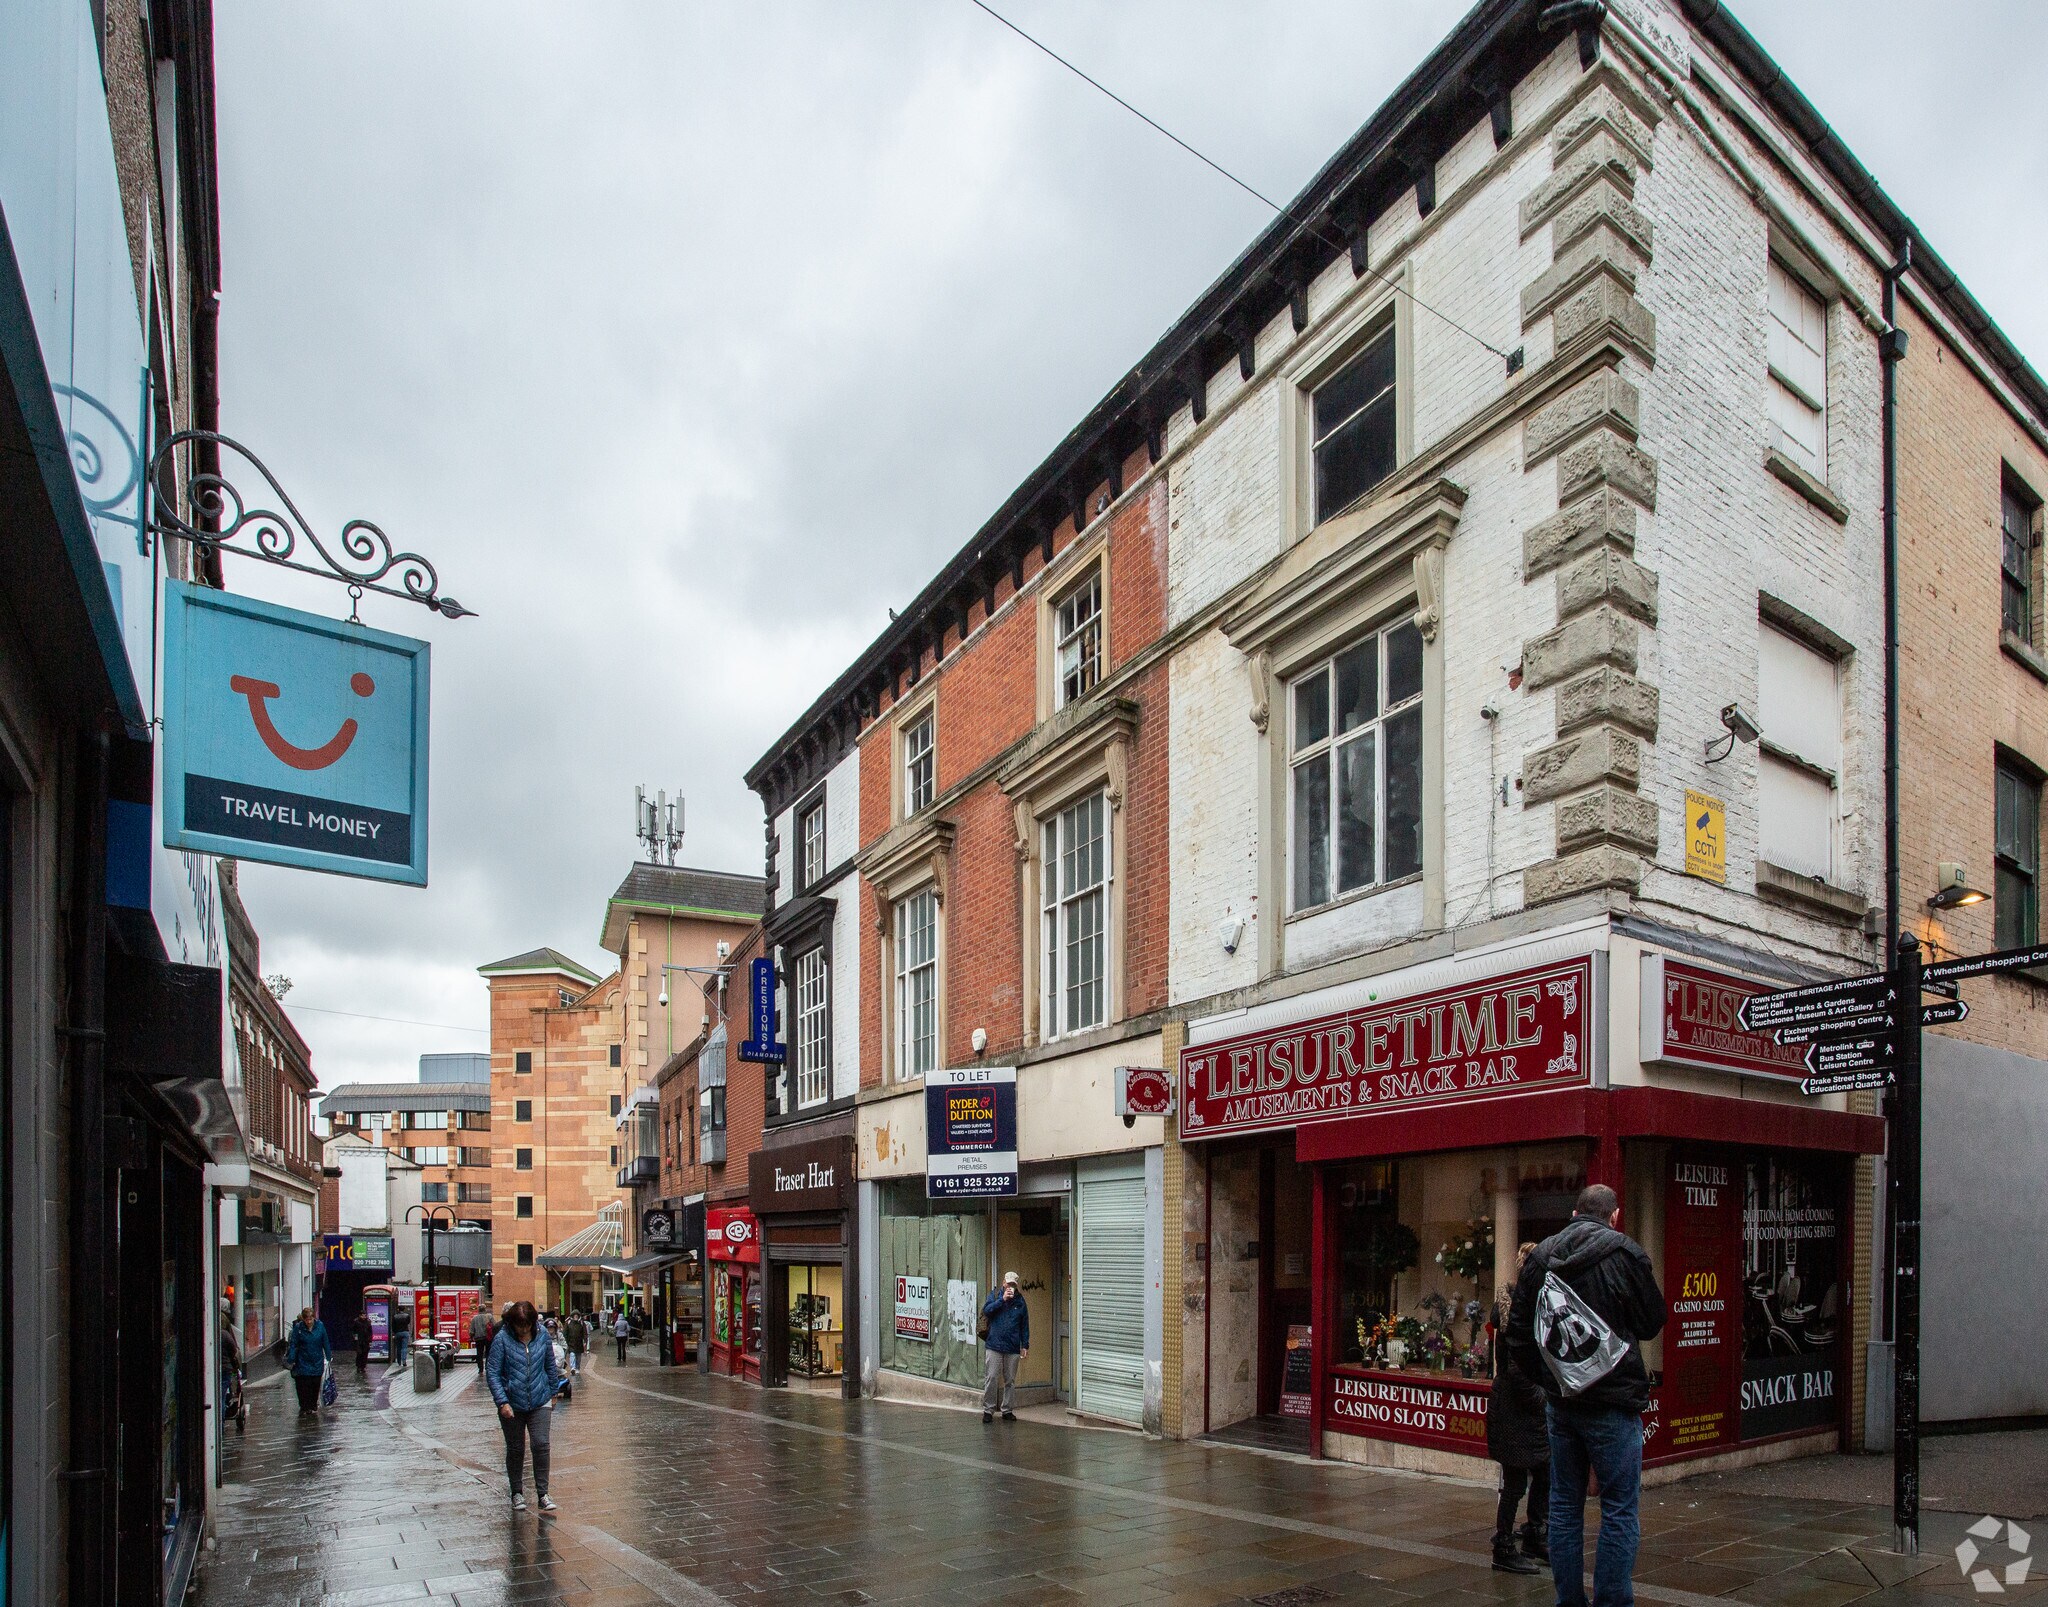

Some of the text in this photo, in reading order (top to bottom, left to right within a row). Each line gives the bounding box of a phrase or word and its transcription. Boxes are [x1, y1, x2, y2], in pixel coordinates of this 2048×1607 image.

[1686, 792, 1724, 813] POLICE NOTICE
[221, 795, 381, 839] TRAVEL MONEY
[1695, 839, 1717, 858] CCTV
[1687, 862, 1700, 872] CCTV
[1933, 961, 1984, 976] Wheatsheaf
[1985, 954, 2030, 968] Shopping
[1751, 975, 1885, 1004] TOWN CENTRE HERITAGE ATTRACTIONS
[760, 967, 769, 1042] PRESTONS
[1751, 1000, 1784, 1012] Town Hall
[1751, 1011, 1769, 1020] Town
[1770, 1006, 1793, 1016] Centre
[1794, 1003, 1815, 1013] Parks
[1824, 998, 1855, 1008] Gardens
[1751, 1016, 1794, 1028] Touchstones
[1795, 1010, 1826, 1020] Museum
[1835, 1006, 1847, 1014] Art
[1847, 1003, 1873, 1013] Gallery
[1933, 1009, 1955, 1018] Taxis
[1784, 1015, 1883, 1036] Exchange Shopping Centre
[1205, 984, 1543, 1101] LEISURETIME
[1690, 1027, 1801, 1063] AMUSEMENTS & SNACK
[1783, 1034, 1808, 1044] Market
[747, 1050, 783, 1060] DIAMONDS
[1819, 1042, 1854, 1053] Metrolink
[1835, 1051, 1862, 1061] Station
[1819, 1058, 1874, 1070] Leisure Centre
[950, 1071, 992, 1082] TO LET
[1128, 1072, 1168, 1091] AMUSEMENTS
[1810, 1071, 1881, 1085] Drake Street Shops
[1143, 1086, 1153, 1098] &
[1222, 1055, 1520, 1123] AMUSEMENTS & SNACK BAR
[1810, 1080, 1884, 1094] Educational Quarter
[950, 1097, 991, 1109] RYDER &
[1130, 1097, 1167, 1112] SNACK BAR
[950, 1109, 993, 1121] DUTTON
[950, 1143, 993, 1151] COMMERCIAL
[775, 1161, 834, 1192] Fraser Hart
[1675, 1163, 1728, 1185] LEISURE
[936, 1176, 1010, 1188] 0161 925 3232
[1685, 1186, 1718, 1206] TIME
[1743, 1208, 1834, 1223] RADITIONAL HOME COOKING
[1743, 1225, 1835, 1241] OT FOOD NOW BEING SERVED
[908, 1285, 928, 1299] TO LET
[1682, 1272, 1717, 1298] £500
[1673, 1300, 1724, 1313] CASINO SLOTS
[897, 1317, 906, 1327] 0113
[1557, 1313, 1592, 1357] JD
[1677, 1337, 1720, 1347] AMUSEMENT AREA
[1334, 1378, 1489, 1415] LEISURETIME AMU
[1740, 1374, 1797, 1410] SNACK
[1802, 1370, 1834, 1399] BAR
[1642, 1399, 1659, 1413] AR
[1334, 1398, 1485, 1438] CASINO SLOTS £500
[1682, 1417, 1693, 1425] CCTV
[1700, 1412, 1724, 1423] OPERATION
[1642, 1416, 1660, 1445] PEN
[1700, 1423, 1715, 1431] ALARM
[1696, 1431, 1720, 1441] OPERATION
